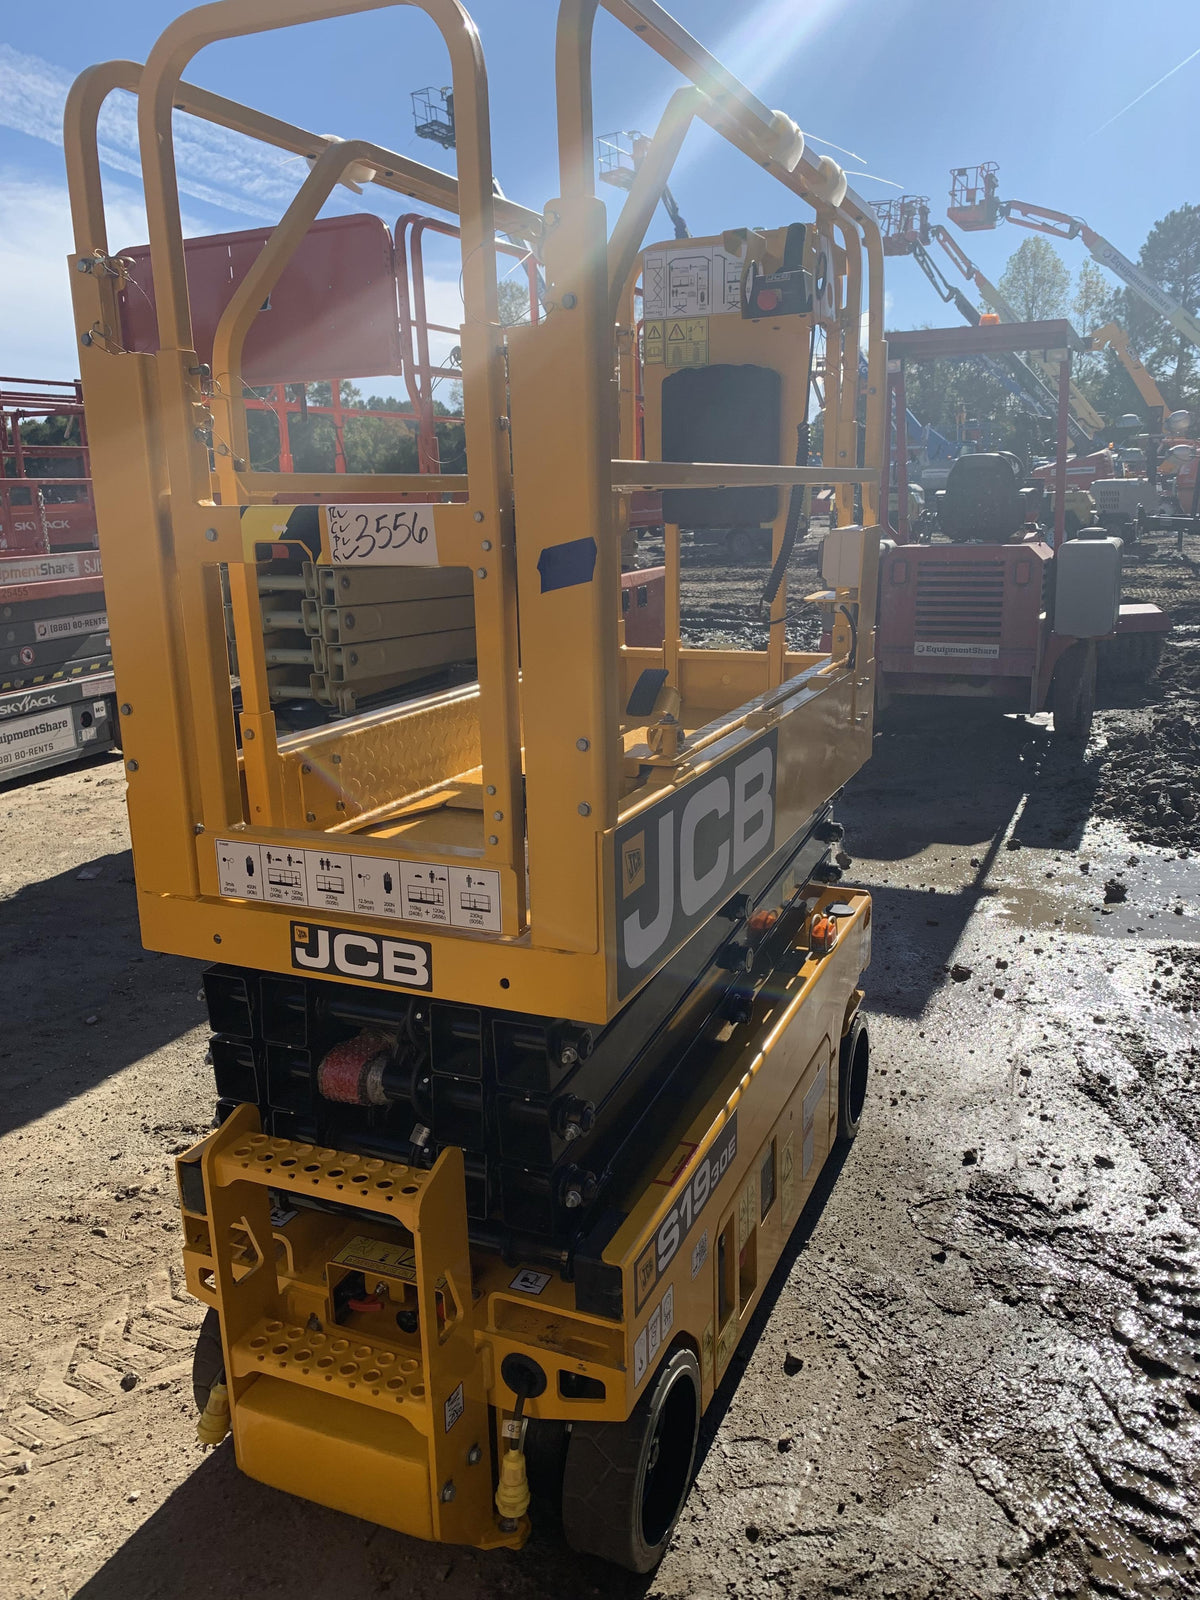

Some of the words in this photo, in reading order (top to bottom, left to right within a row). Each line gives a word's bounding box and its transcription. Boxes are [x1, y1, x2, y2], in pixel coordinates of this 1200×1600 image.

[355, 512, 428, 557] 3556
[925, 645, 998, 656] EquipmentShare
[0, 694, 57, 715] SKYJACK
[15, 742, 54, 760] 80-RENTS
[623, 746, 773, 969] JCB
[295, 929, 429, 986] JCB
